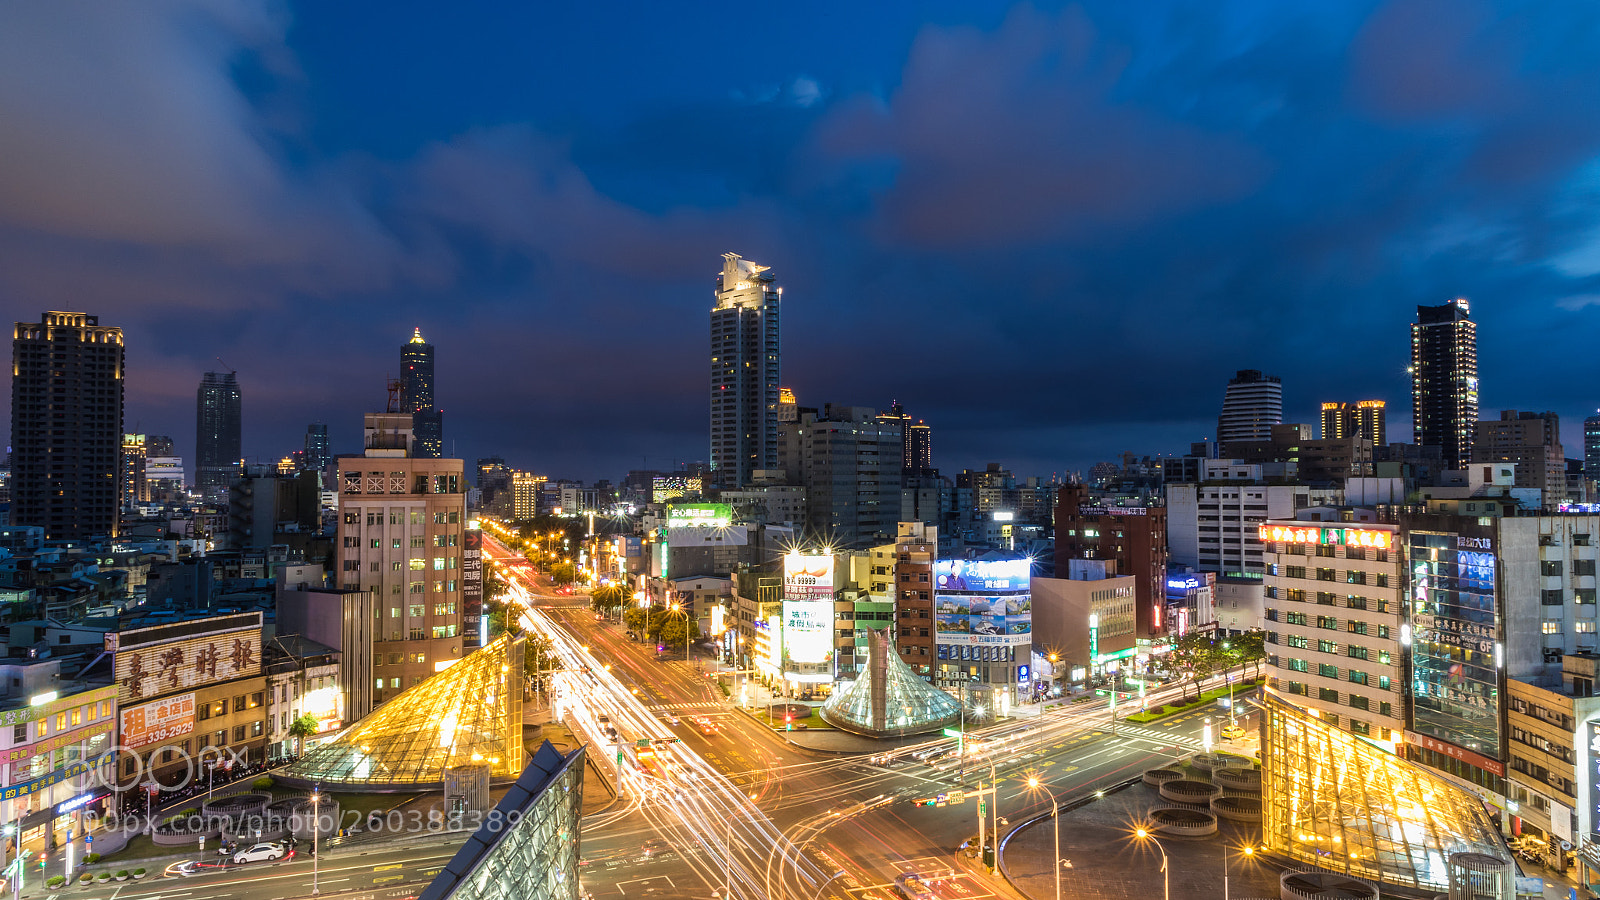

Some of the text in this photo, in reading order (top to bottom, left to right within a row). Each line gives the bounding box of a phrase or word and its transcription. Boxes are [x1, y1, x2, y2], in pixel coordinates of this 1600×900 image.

[1347, 531, 1386, 548] 大飯店
[1480, 640, 1492, 653] 6F
[122, 638, 259, 698] 臺灣時報
[157, 699, 194, 719] 金店面
[124, 707, 146, 739] 租
[147, 721, 194, 744] 339-2929
